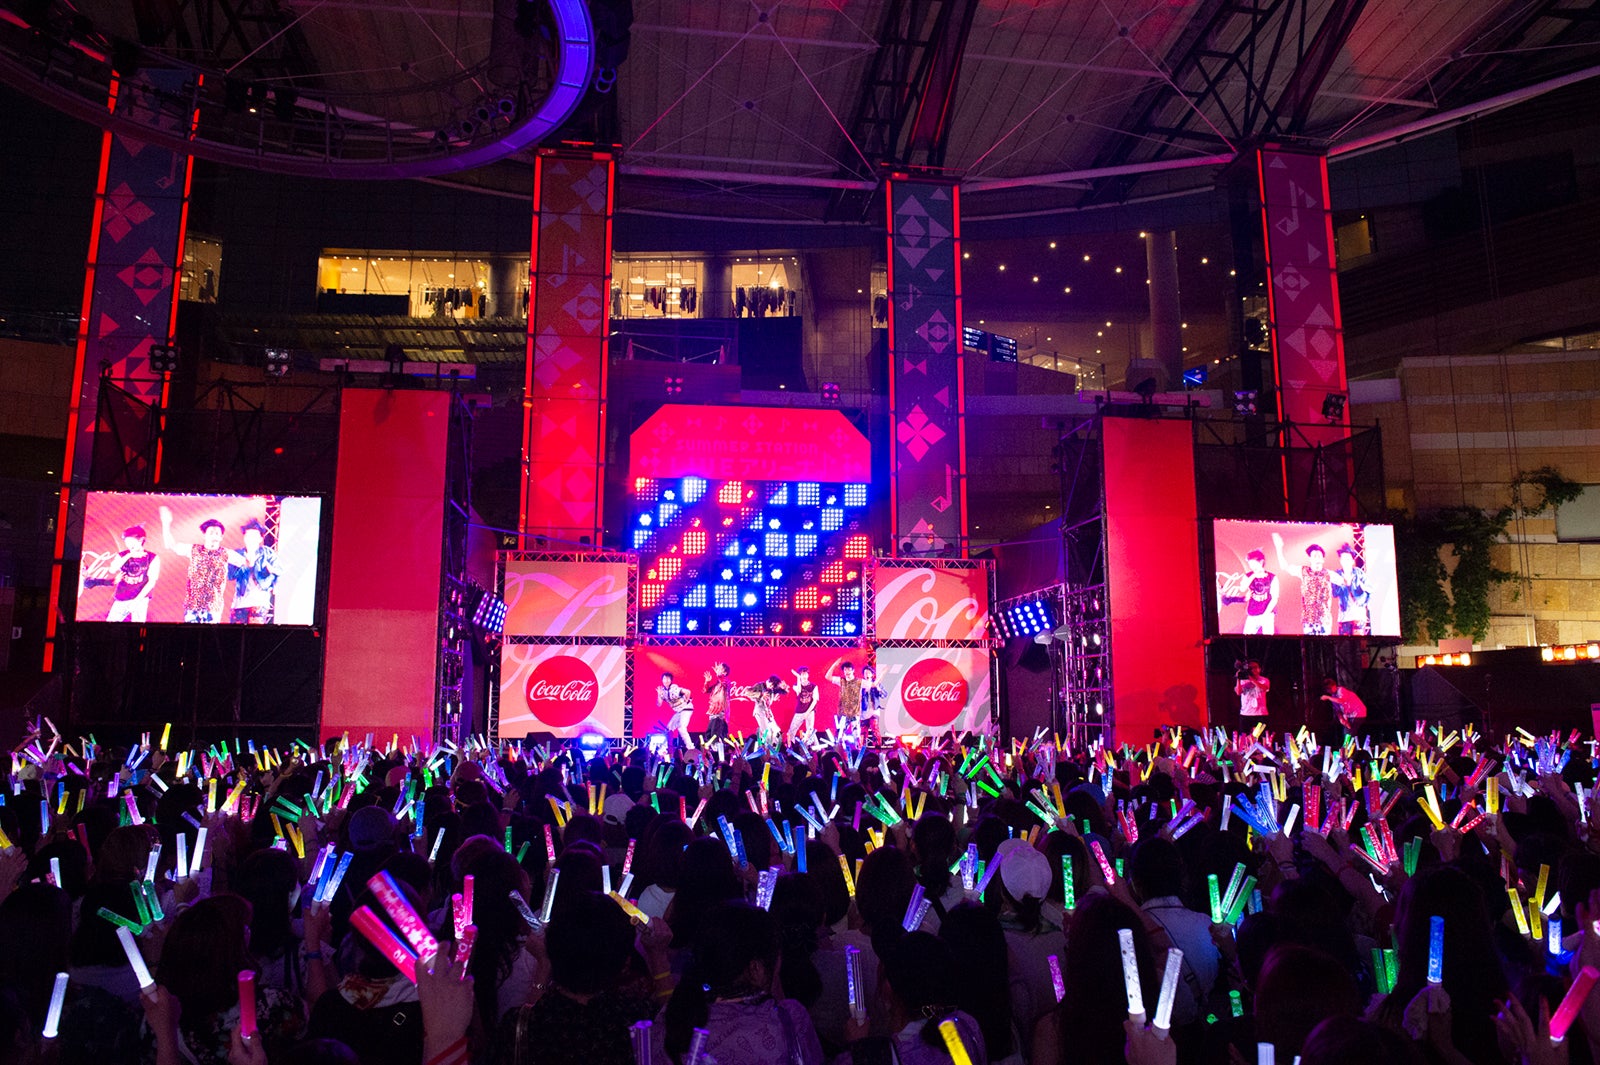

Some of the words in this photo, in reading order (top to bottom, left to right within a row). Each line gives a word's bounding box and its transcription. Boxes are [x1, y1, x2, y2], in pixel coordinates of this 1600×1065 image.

[675, 438, 749, 454] SUMMER
[754, 440, 818, 456] STATION
[529, 679, 596, 701] Coca-Cola
[904, 681, 963, 702] Coca-Cola
